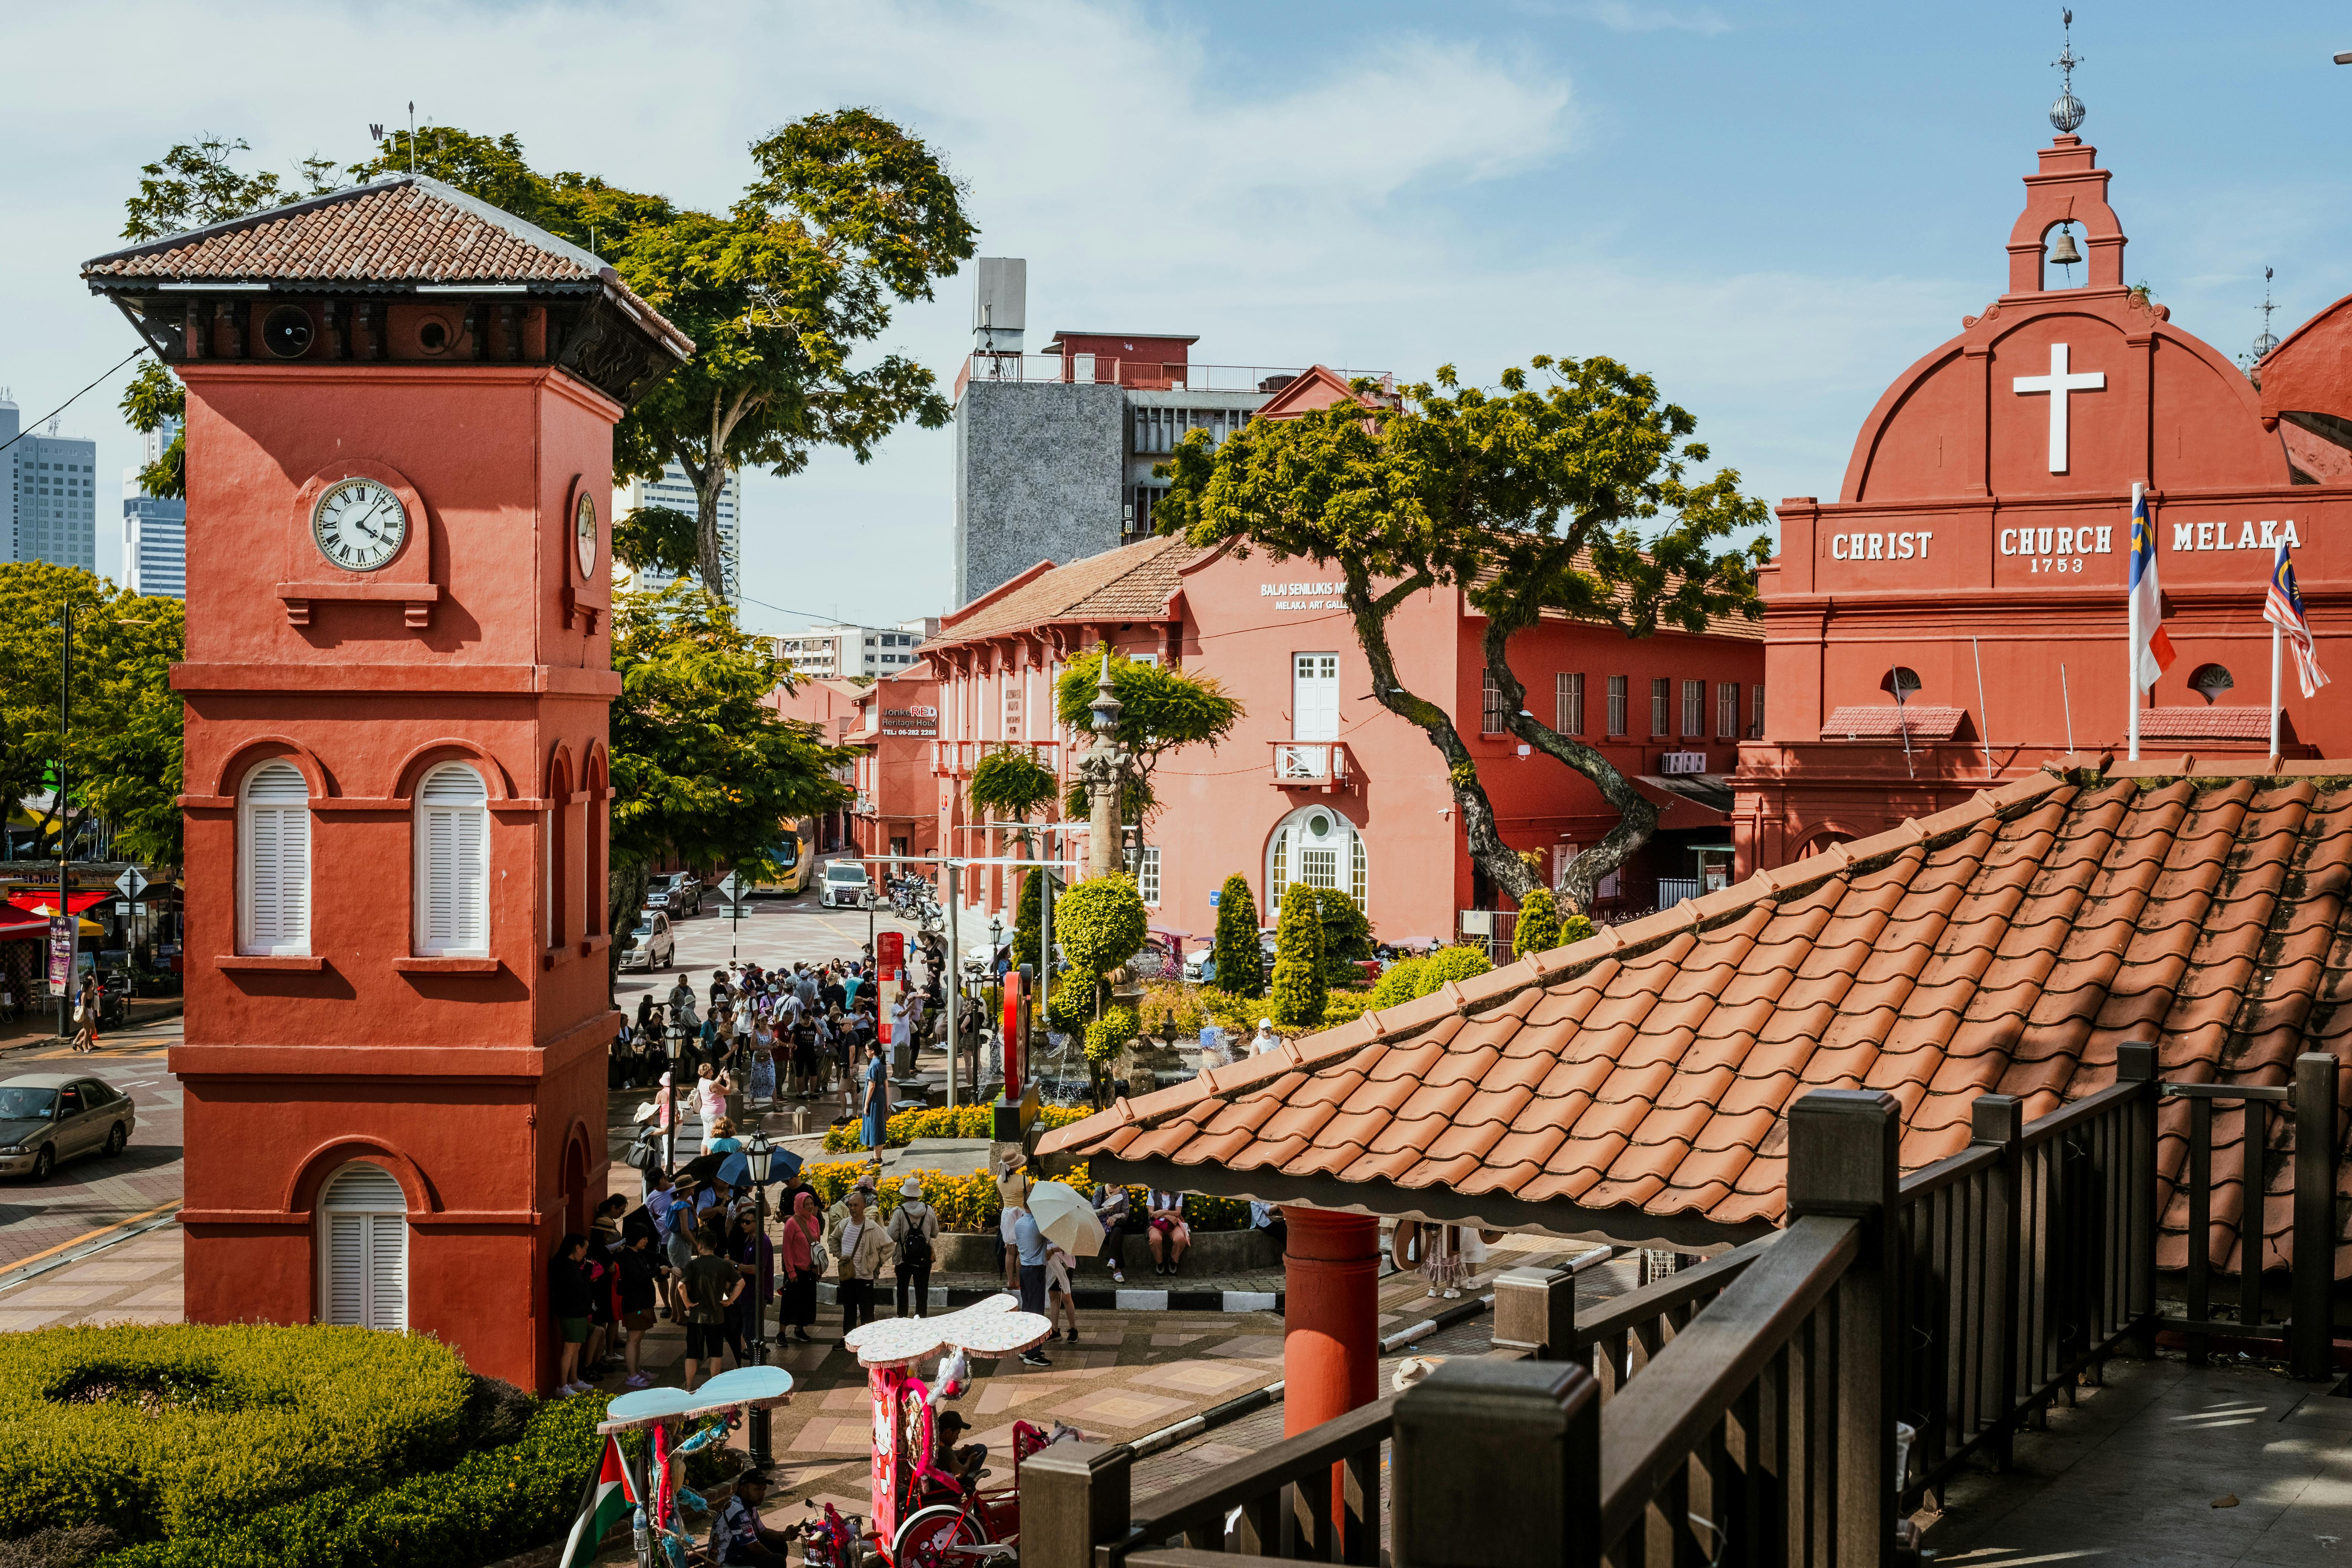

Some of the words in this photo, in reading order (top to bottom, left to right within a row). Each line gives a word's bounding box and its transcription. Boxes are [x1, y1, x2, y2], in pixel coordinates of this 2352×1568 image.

[369, 124, 383, 141] W
[338, 490, 352, 507] XI
[356, 487, 365, 501] XII
[326, 504, 341, 516] X
[380, 505, 394, 514] II
[1832, 532, 1933, 559] CHRIST
[2000, 526, 2112, 555] CHURCH
[2173, 520, 2301, 550] MELAKA
[338, 544, 351, 560] VII
[357, 549, 366, 563] VI
[372, 546, 382, 559] V
[2031, 559, 2083, 573] 1753
[1261, 583, 1288, 596] BALAI
[1275, 600, 1306, 610] MELAKA
[1309, 600, 1325, 610] ART
[882, 719, 914, 727] Heritage
